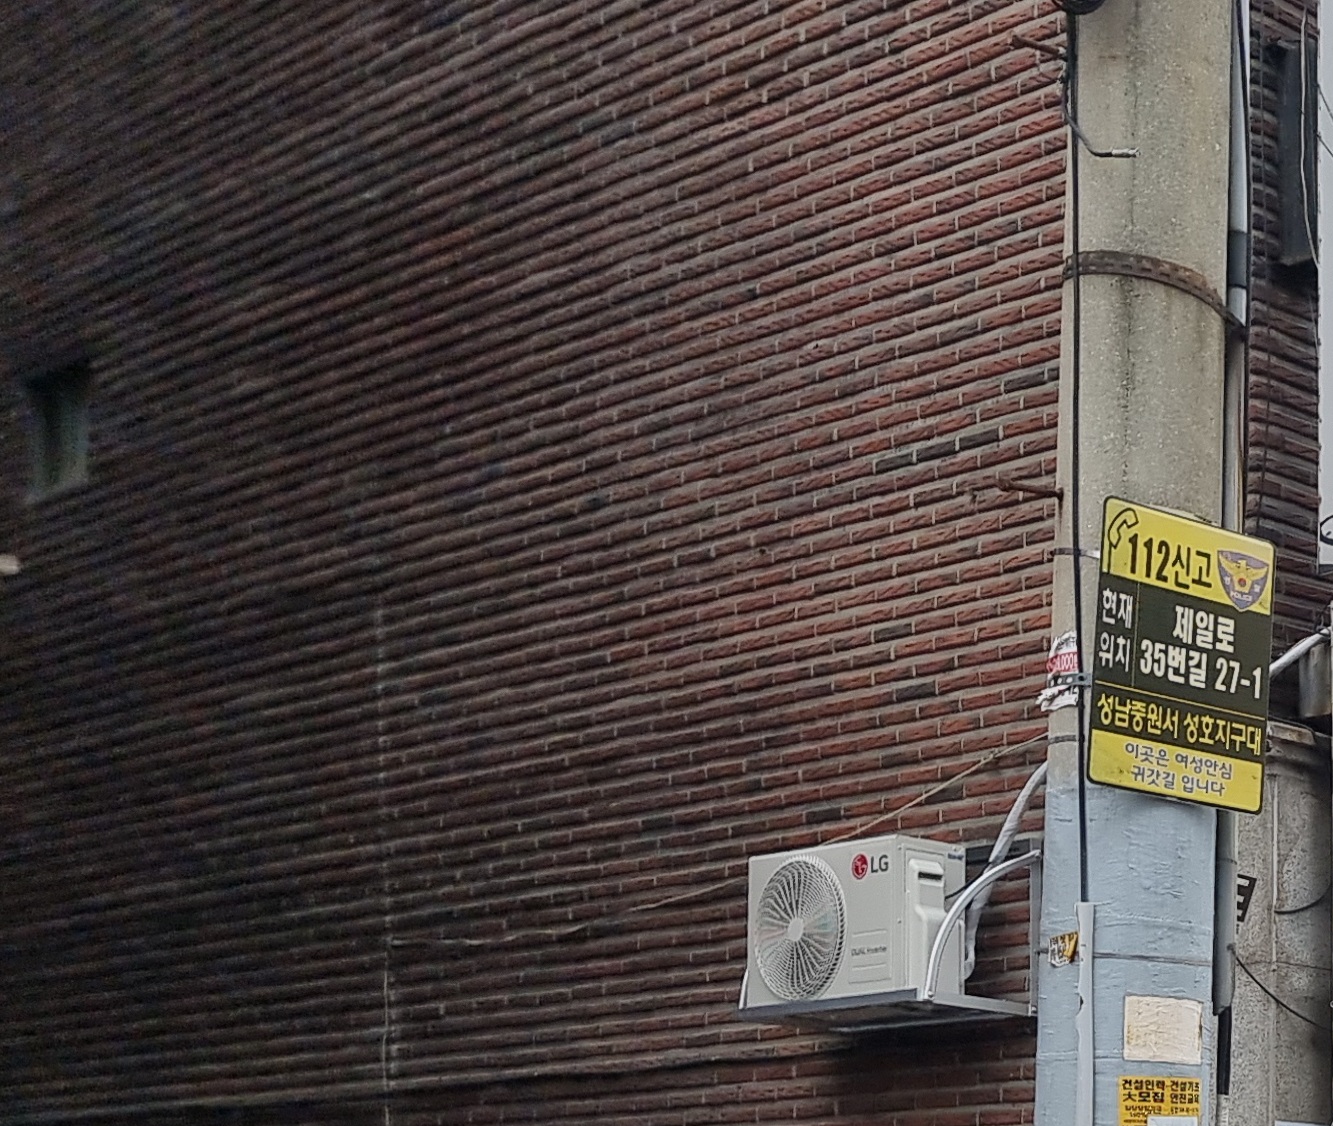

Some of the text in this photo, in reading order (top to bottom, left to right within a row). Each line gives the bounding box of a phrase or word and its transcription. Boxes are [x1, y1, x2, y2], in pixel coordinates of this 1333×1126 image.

[1128, 533, 1212, 589] 112신고
[1102, 588, 1133, 629] 현재
[1173, 605, 1235, 653] 제일로
[1099, 633, 1130, 672] 위치
[1140, 639, 1261, 699] 35번길 27-1
[1097, 693, 1261, 756] 성남중원서 성호지구대
[1125, 742, 1233, 780] 이곳은 여성안심
[1131, 765, 1225, 796] 귀갓길 입니다
[870, 855, 889, 874] LG
